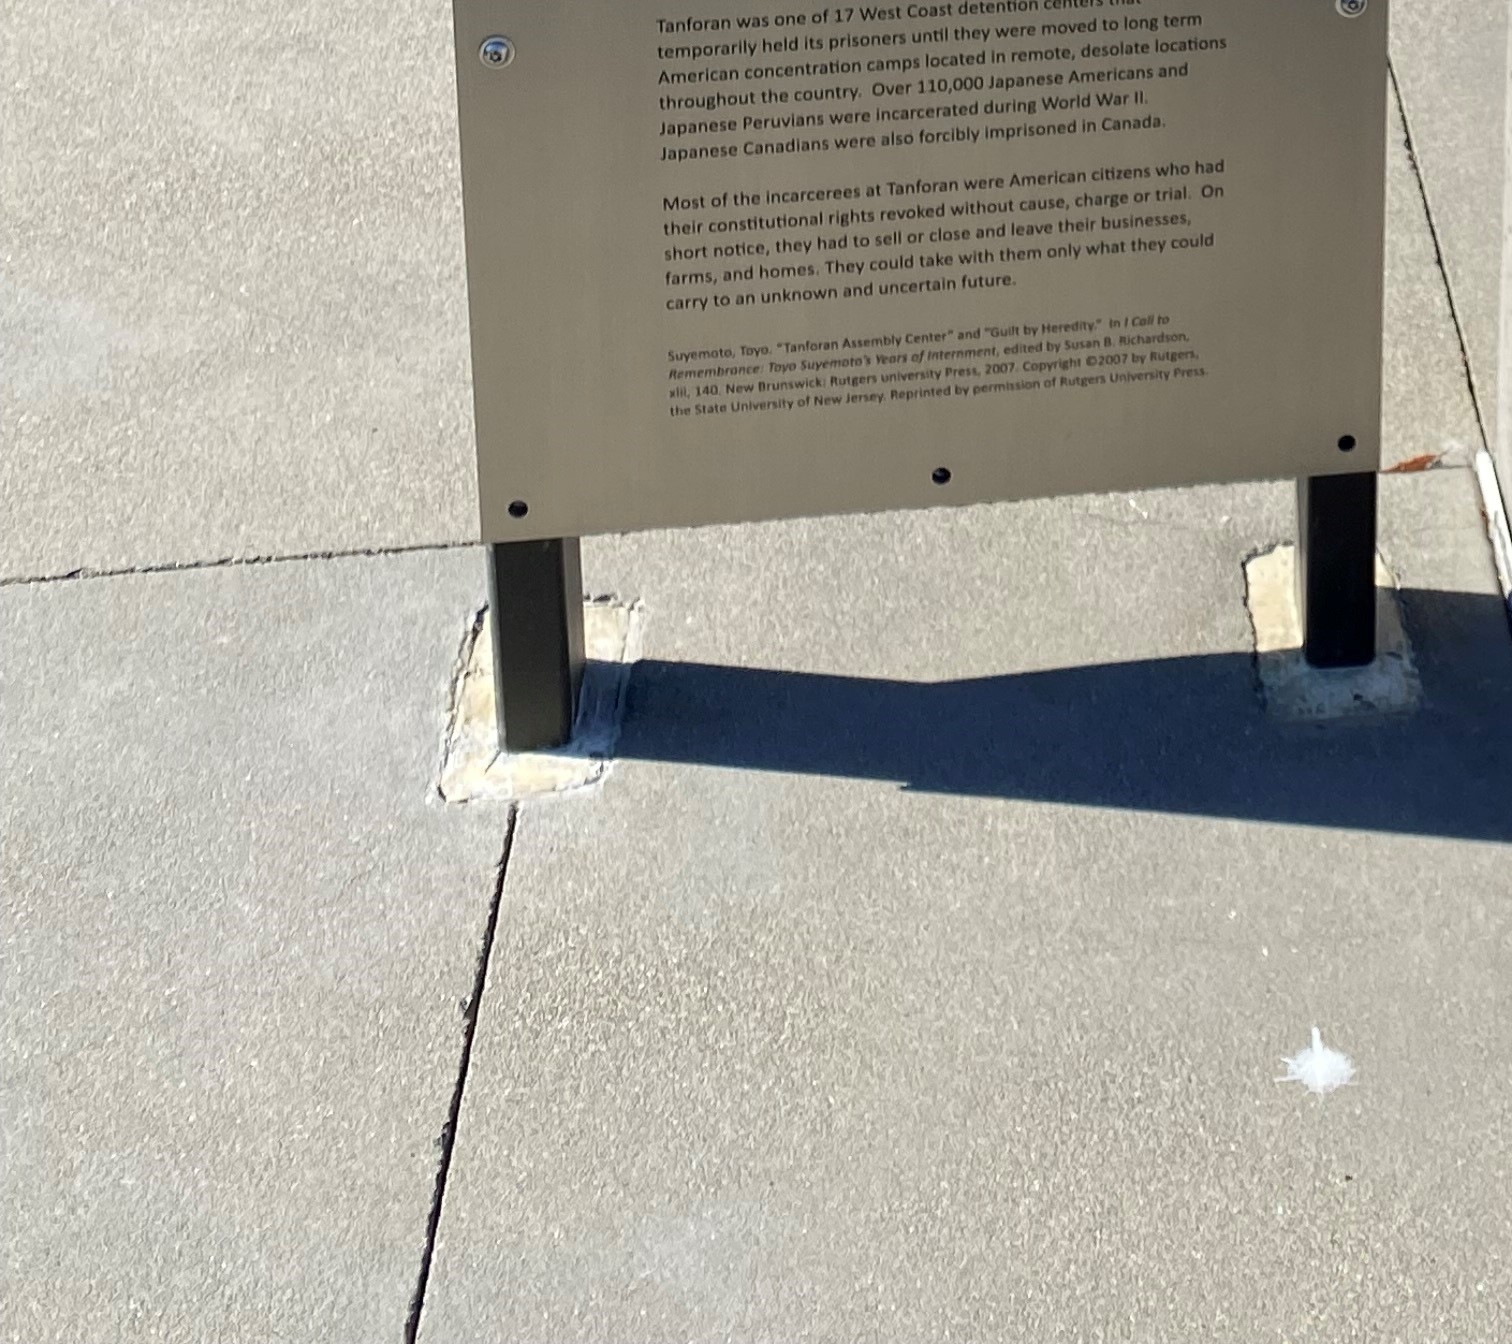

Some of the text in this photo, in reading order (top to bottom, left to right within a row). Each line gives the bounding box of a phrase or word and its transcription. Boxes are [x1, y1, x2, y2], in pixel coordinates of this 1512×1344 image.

[658, 37, 1226, 85] American concentration camps located in remote, desolate locations
[670, 367, 1208, 417] the State University of New Jersey. Reprinted by permission of Rutgers University Press.
